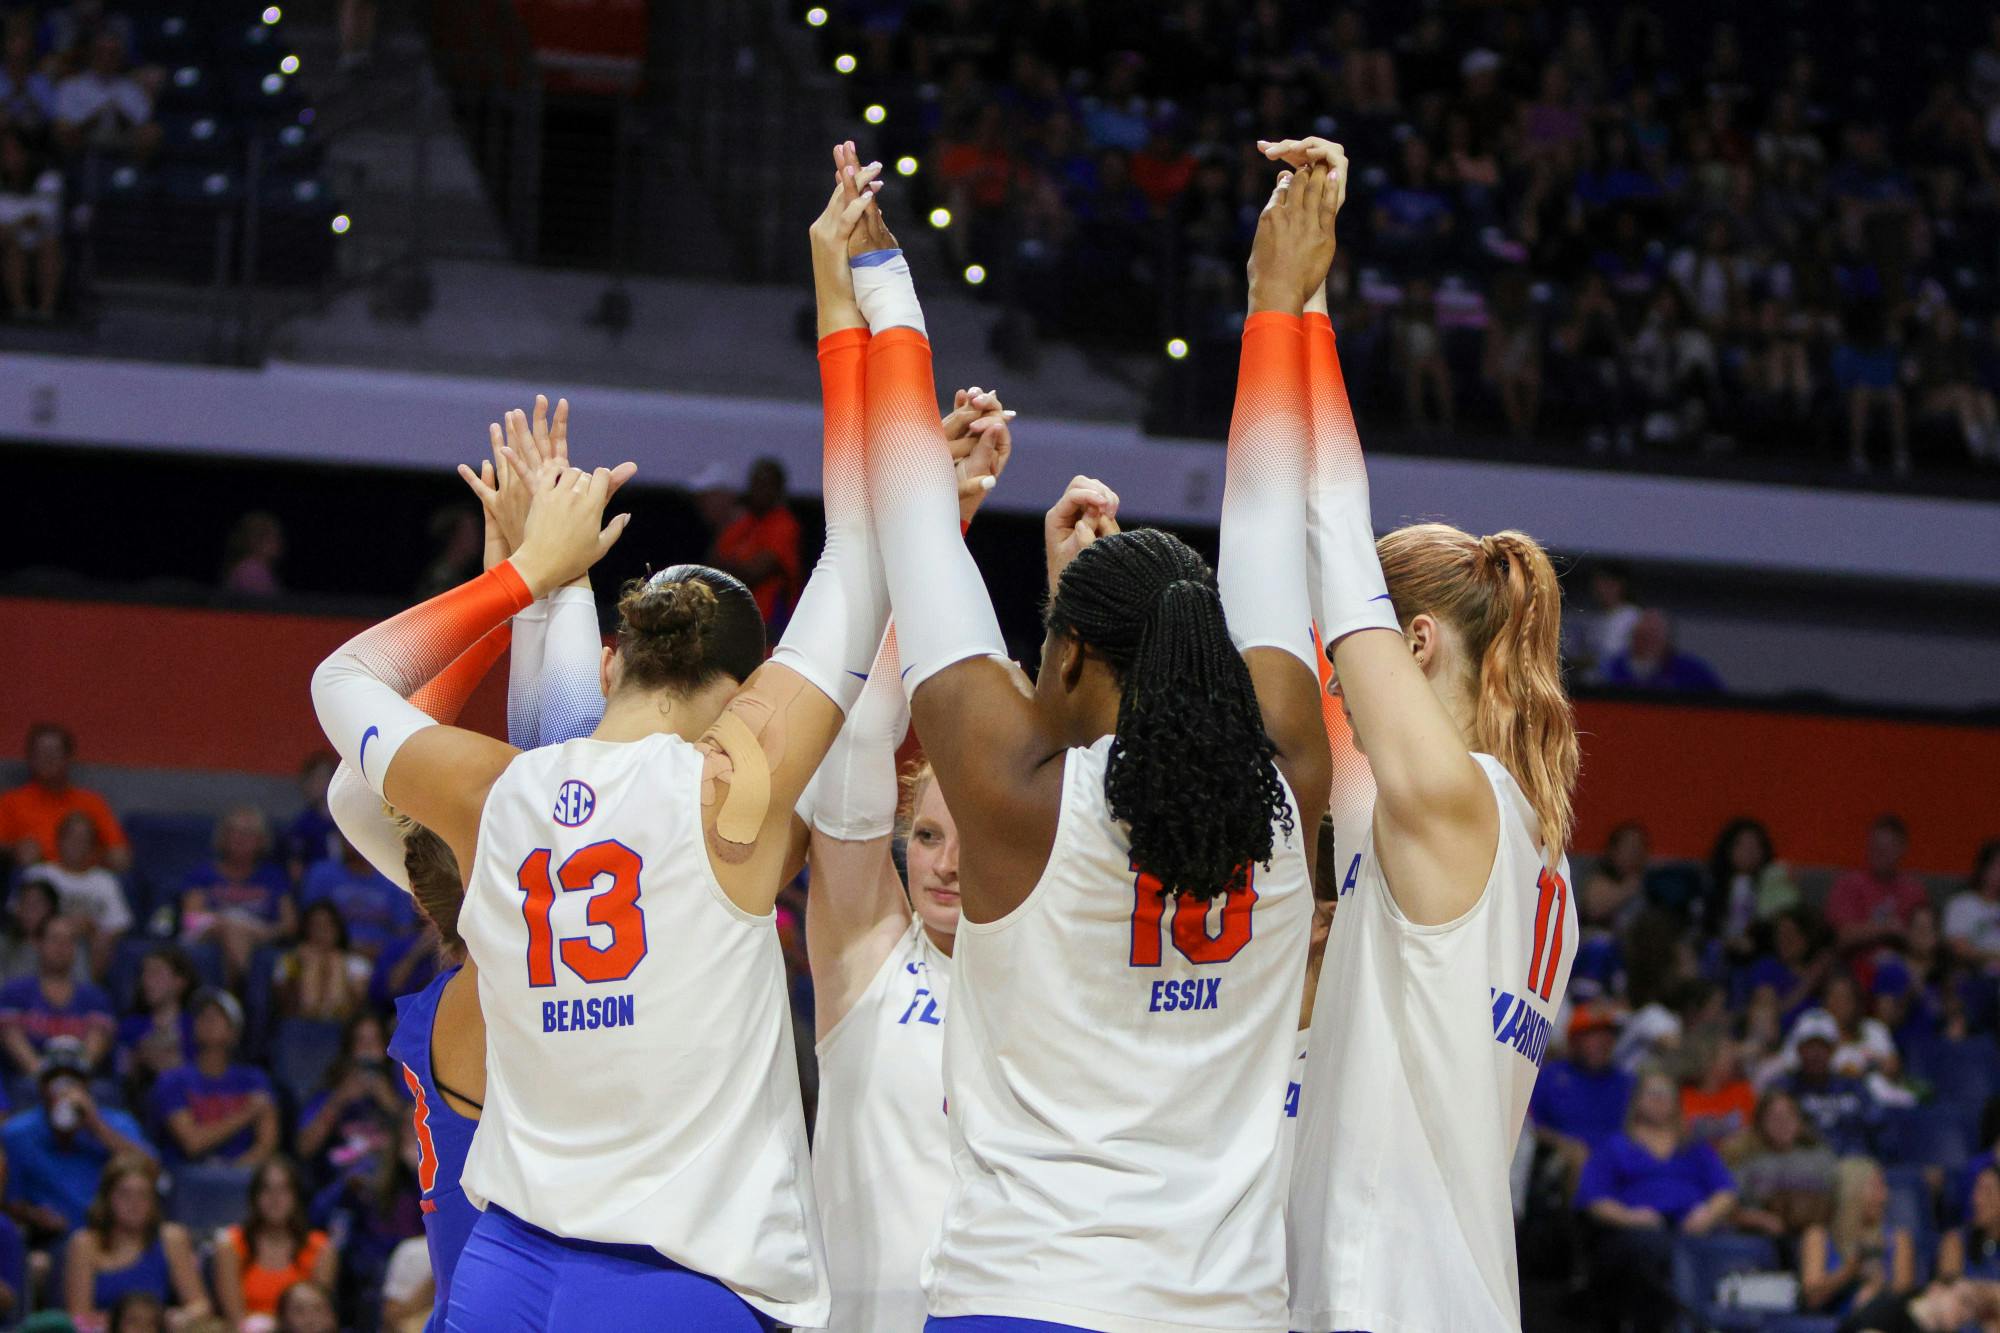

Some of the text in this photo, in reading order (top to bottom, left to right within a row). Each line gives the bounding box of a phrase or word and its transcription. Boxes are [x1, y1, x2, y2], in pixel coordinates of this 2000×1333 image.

[554, 781, 594, 826] SEC
[517, 838, 648, 988] 13
[1129, 850, 1259, 968] 10
[1528, 866, 1567, 1004] 11
[543, 994, 634, 1033] BEASON
[1149, 977, 1222, 1012] ESSIX
